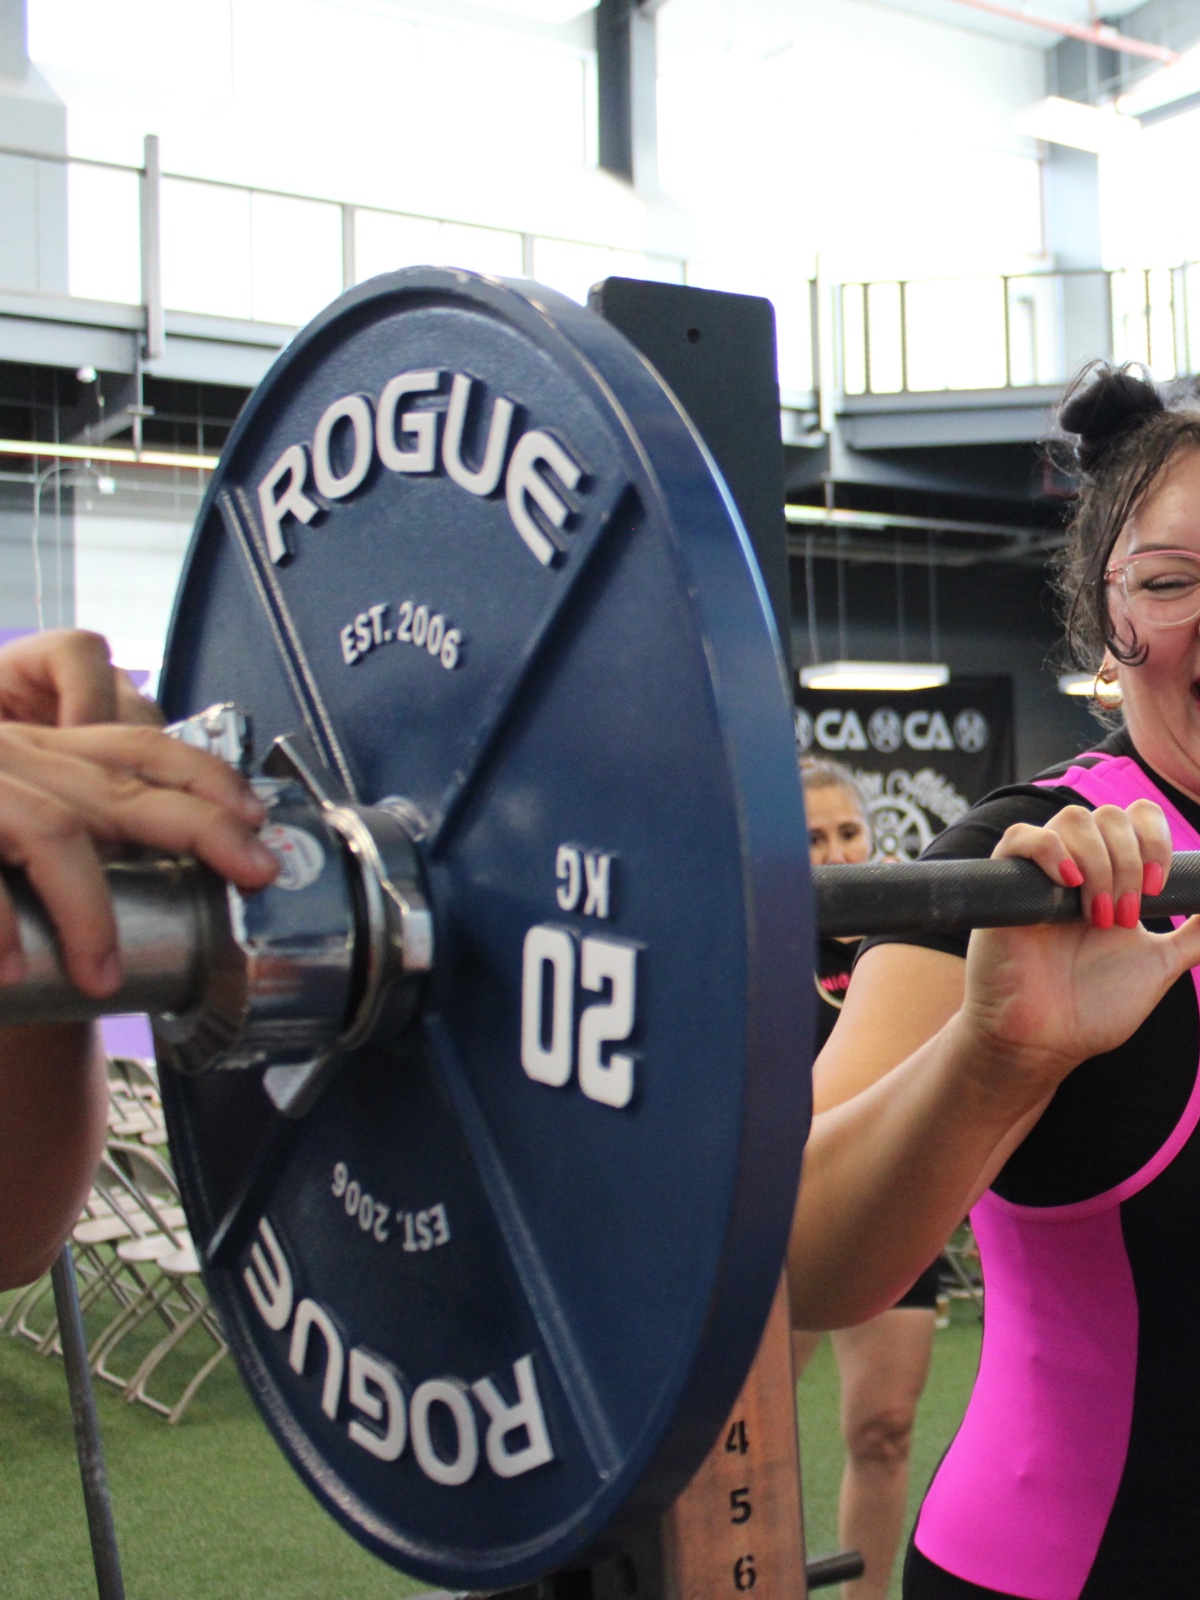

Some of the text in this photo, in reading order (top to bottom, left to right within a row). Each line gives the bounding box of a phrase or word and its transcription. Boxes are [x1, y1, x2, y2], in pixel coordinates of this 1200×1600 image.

[257, 369, 584, 566] ROGUE
[340, 600, 461, 670] EST. 2006
[814, 708, 954, 751] CA CA
[556, 844, 612, 918] KG
[521, 924, 638, 1109] 20
[331, 1161, 451, 1252] EST. 2006
[243, 1215, 555, 1486] ROGUE
[725, 1420, 749, 1456] 4
[730, 1487, 752, 1525] 5
[733, 1554, 757, 1591] 6
